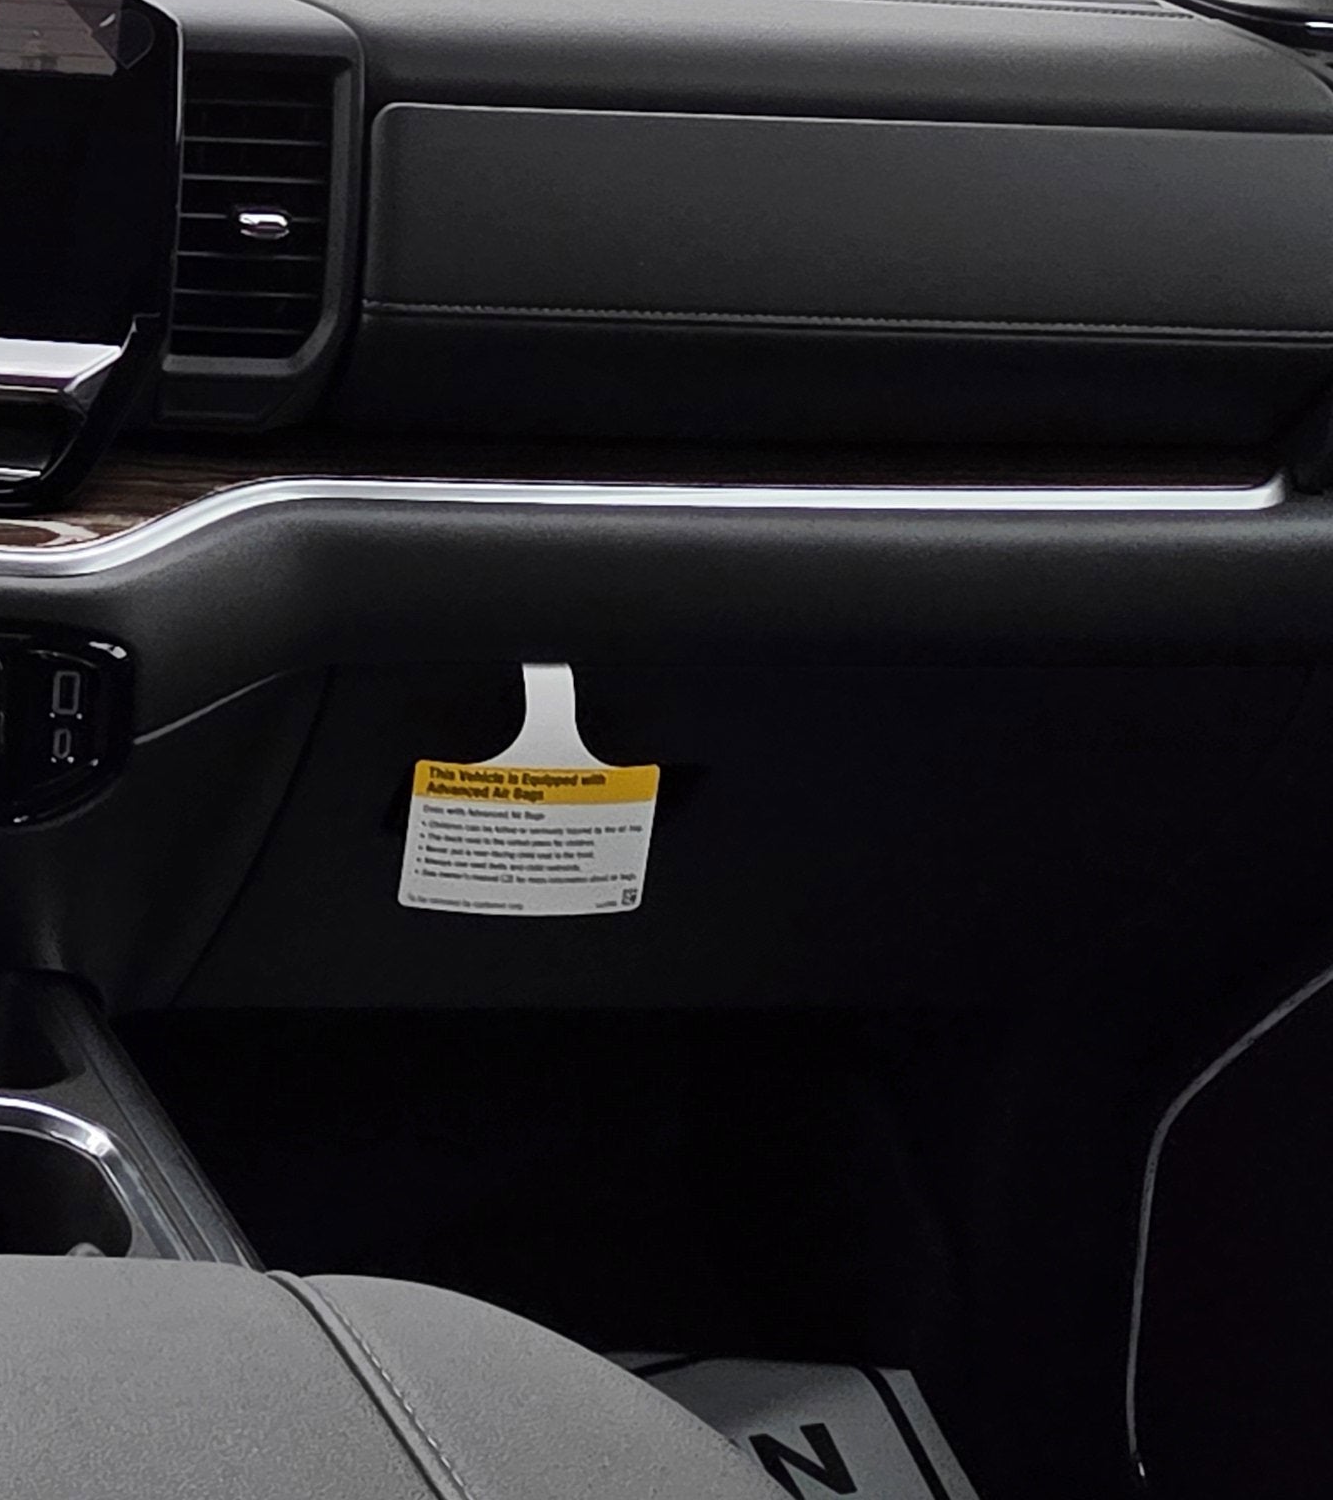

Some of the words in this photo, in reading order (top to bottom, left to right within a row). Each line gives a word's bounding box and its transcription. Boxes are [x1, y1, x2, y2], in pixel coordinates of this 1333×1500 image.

[429, 765, 455, 781] This
[458, 770, 504, 784] Vehicle
[507, 772, 519, 785] is
[520, 772, 578, 788] Equipped
[580, 773, 606, 786] with
[425, 780, 490, 798] Advanced
[491, 786, 510, 798] Air
[512, 786, 545, 803] Bags
[729, 1422, 858, 1499] N
